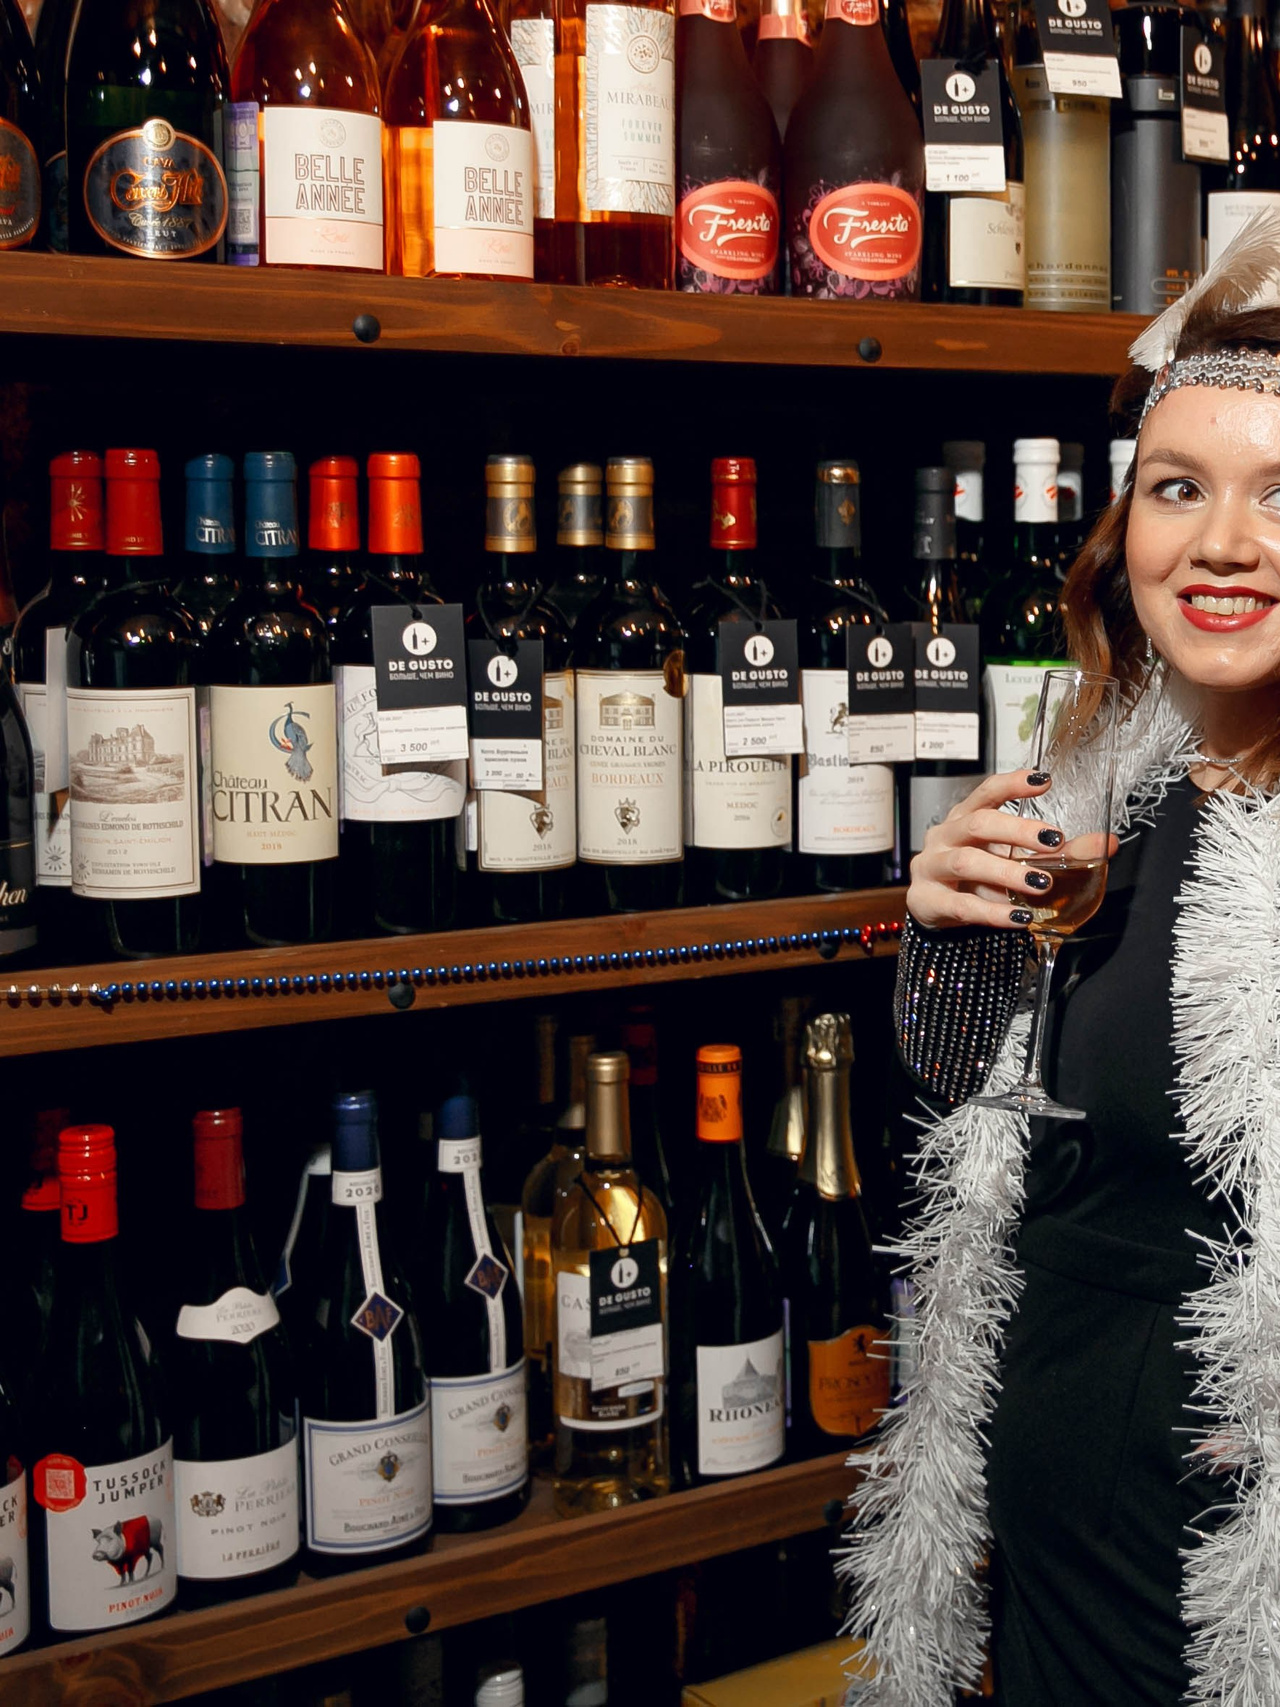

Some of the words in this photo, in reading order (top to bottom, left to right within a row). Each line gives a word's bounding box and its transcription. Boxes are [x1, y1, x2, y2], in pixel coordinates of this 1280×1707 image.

[1048, 18, 1062, 28] DE
[1066, 19, 1102, 30] GUSTO
[607, 91, 670, 110] MIRABEAU
[933, 104, 948, 115] DE
[951, 104, 990, 115] GUSTO
[294, 153, 365, 185] BELLE
[464, 166, 523, 198] BELLE
[295, 182, 366, 215] ANNÉE
[465, 195, 524, 227] ANNÉE
[688, 204, 772, 242] Fresita
[823, 207, 909, 244] Fresita
[388, 660, 406, 671] DE
[408, 659, 454, 671] GUSTO
[732, 670, 747, 681] DE
[749, 669, 788, 681] GUSTO
[856, 671, 870, 682] DE
[873, 670, 904, 682] GUSTO
[915, 669, 928, 680] DE
[931, 669, 968, 681] GUSTO
[474, 692, 489, 702] DE
[492, 692, 532, 703] GUSTO
[409, 742, 428, 752] 500
[591, 735, 644, 743] DOMAINE
[649, 735, 665, 743] DU
[579, 744, 630, 756] CHEVAL
[633, 744, 677, 757] BLANC
[213, 770, 268, 789] Château
[591, 773, 664, 784] BORDEAUX
[212, 786, 333, 823] CITRAN
[101, 823, 130, 831] EDMOND
[131, 823, 142, 831] DE
[142, 820, 184, 831] ROTHSCHILD
[598, 1293, 613, 1307] DE
[615, 1287, 651, 1304] GUSTO
[328, 1442, 372, 1467] GRAND
[92, 1458, 167, 1492] TUSSOCK
[97, 1474, 164, 1505] JUMPER
[210, 1523, 253, 1535] PINOT
[108, 1596, 141, 1614] PINOT
